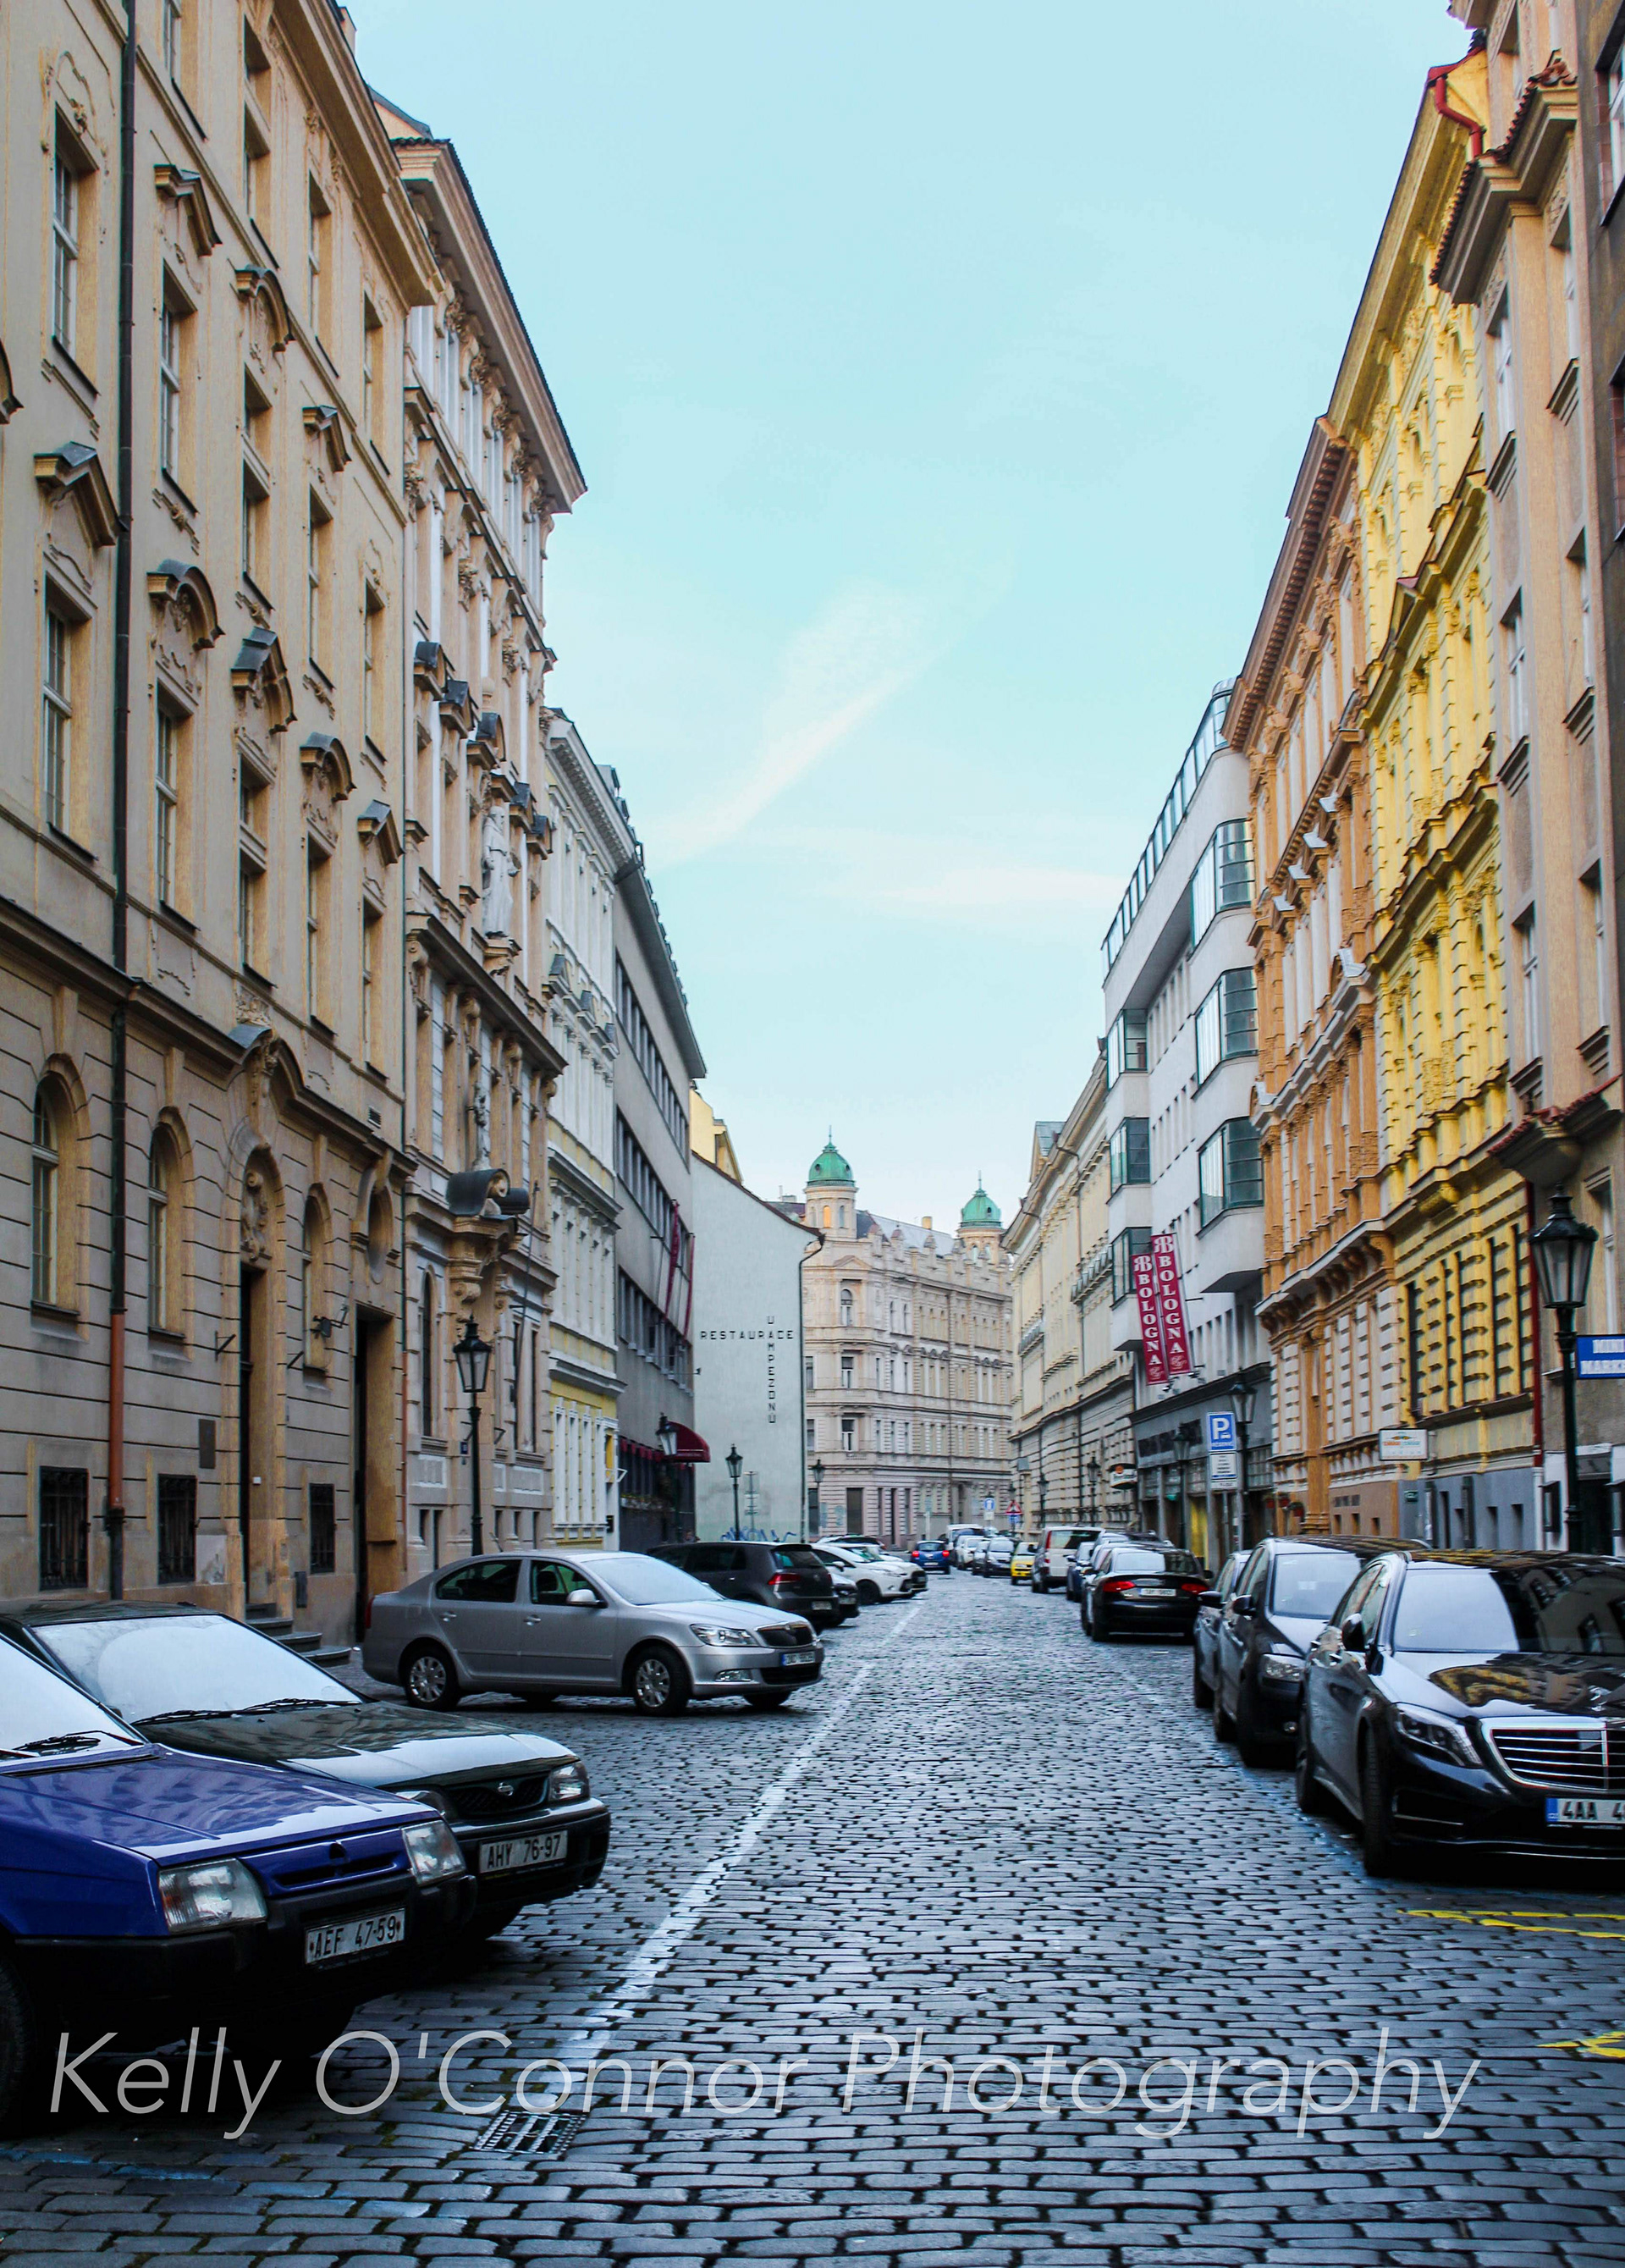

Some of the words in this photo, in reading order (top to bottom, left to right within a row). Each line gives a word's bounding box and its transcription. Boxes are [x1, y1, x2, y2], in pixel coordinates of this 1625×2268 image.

[1138, 1273, 1162, 1366] BOLOGNA
[1158, 1255, 1185, 1354] BOLOGNA
[700, 1330, 794, 1339] RESTAURACE
[1212, 1417, 1230, 1440] P
[1562, 1801, 1598, 1821] 4AA
[1611, 1802, 1625, 1821] 4
[487, 1843, 513, 1869] AHY
[524, 1834, 560, 1863] 76-97
[314, 1927, 344, 1958] AEF
[355, 1915, 396, 1947] 47-59
